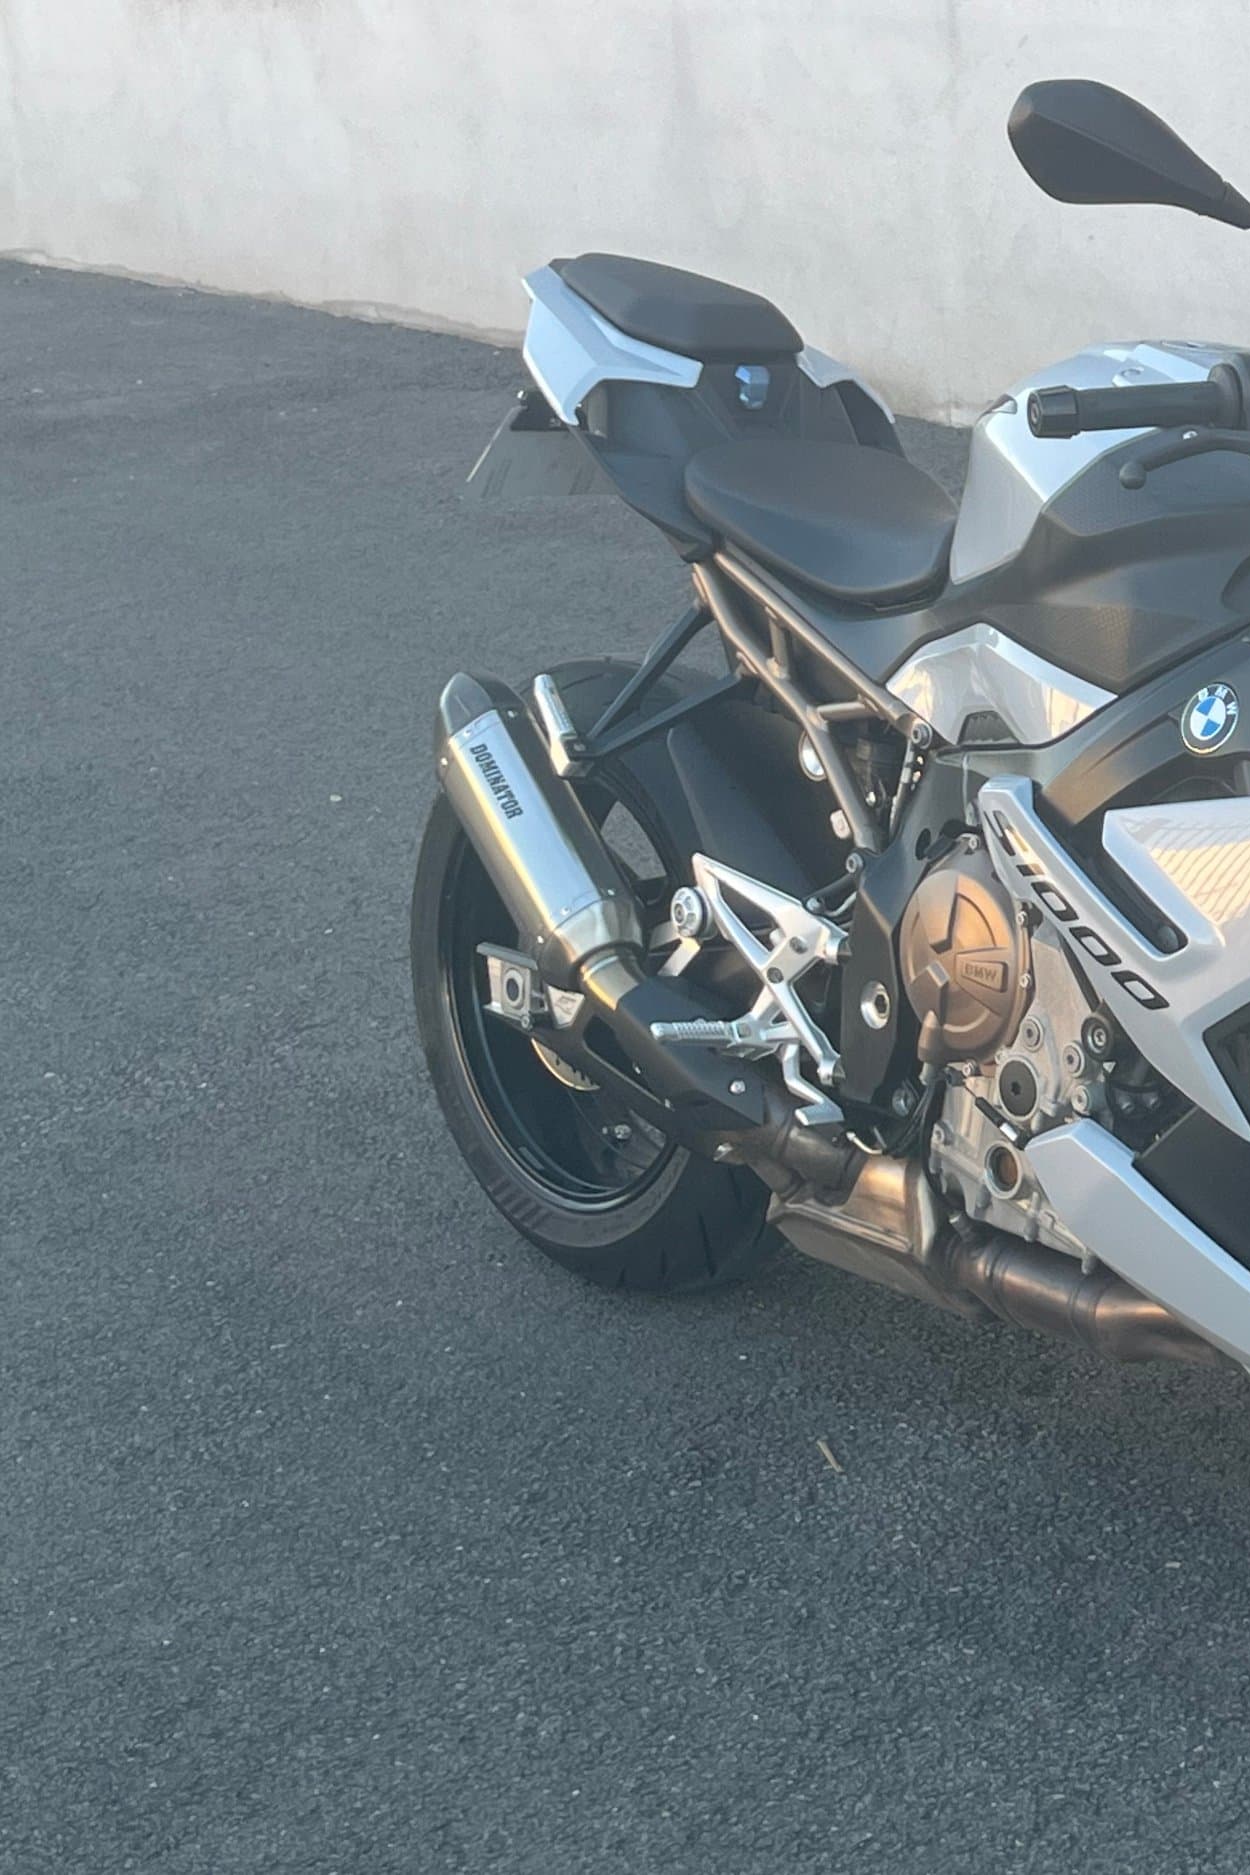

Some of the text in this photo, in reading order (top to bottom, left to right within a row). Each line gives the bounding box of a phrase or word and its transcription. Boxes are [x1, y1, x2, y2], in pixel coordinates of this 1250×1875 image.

[1198, 686, 1238, 715] BMW
[470, 743, 524, 820] DOMINATOR
[964, 962, 998, 981] BMW
